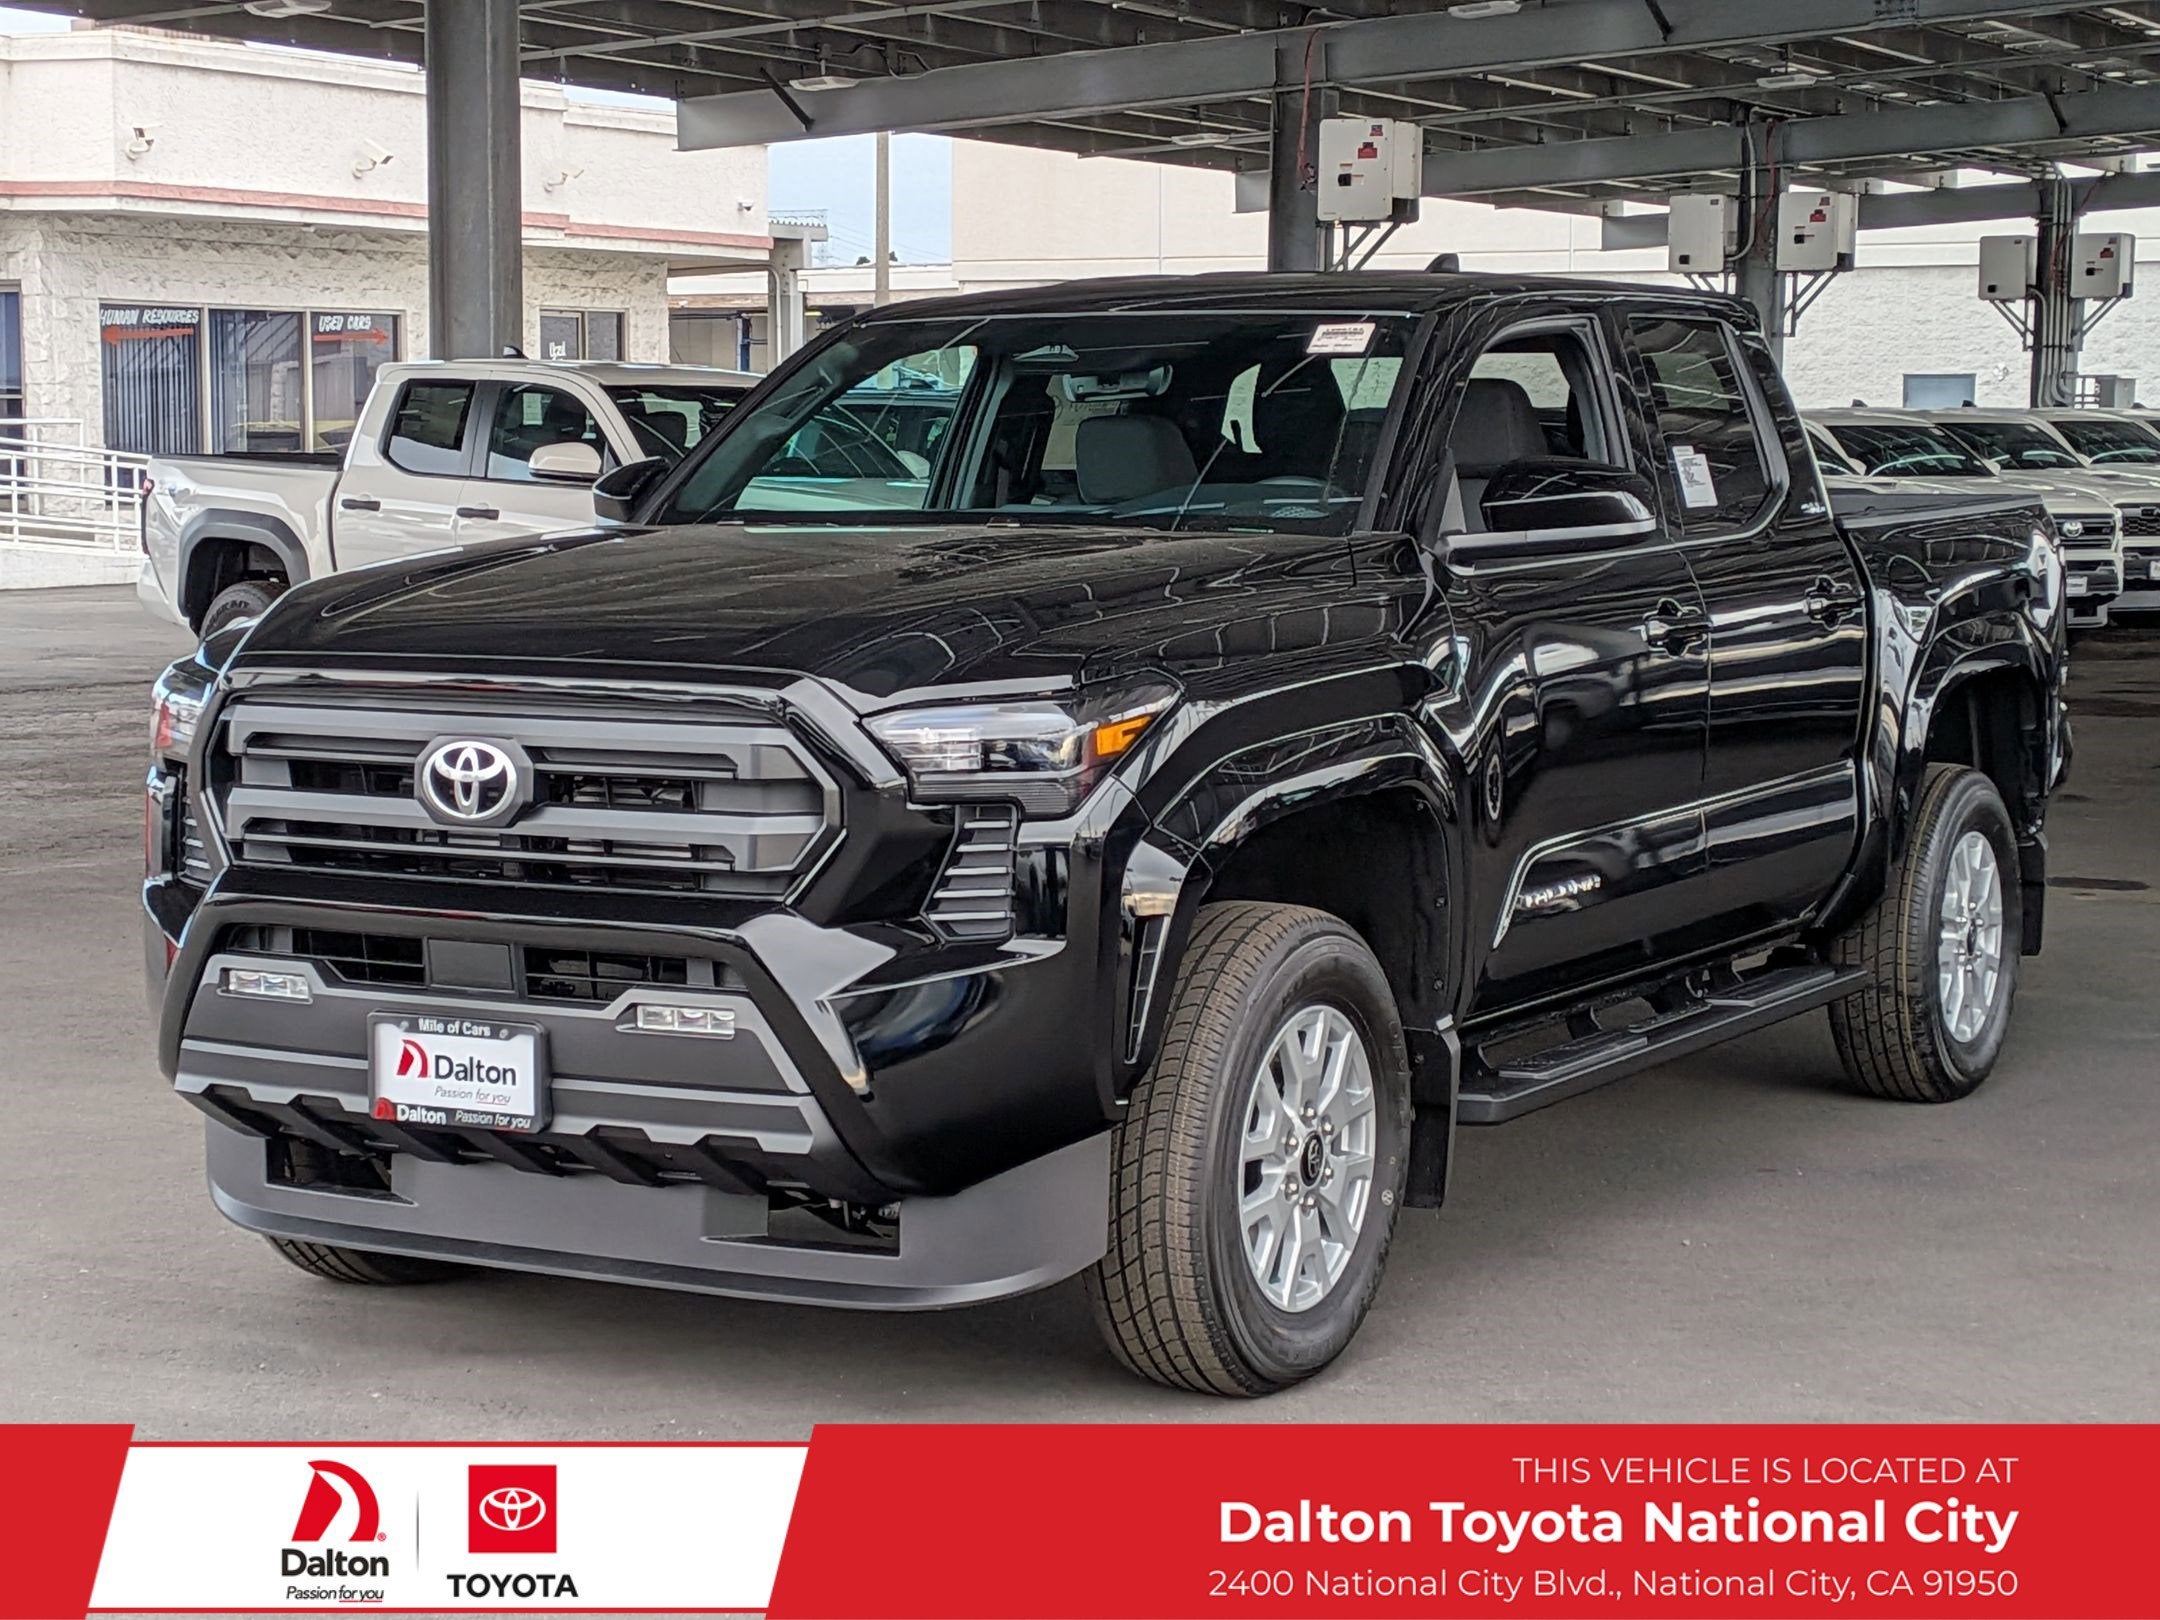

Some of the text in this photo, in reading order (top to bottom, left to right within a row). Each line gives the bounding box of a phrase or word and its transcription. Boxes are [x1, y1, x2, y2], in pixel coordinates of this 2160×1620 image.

[101, 309, 199, 326] HUMAN RESOURCES
[319, 315, 343, 332] USED
[418, 1018, 491, 1037] Mile of Cars
[434, 1054, 516, 1086] Dalton
[434, 1086, 511, 1104] Passion for you
[396, 1104, 447, 1125] Dalton
[455, 1110, 531, 1129] Passion for you
